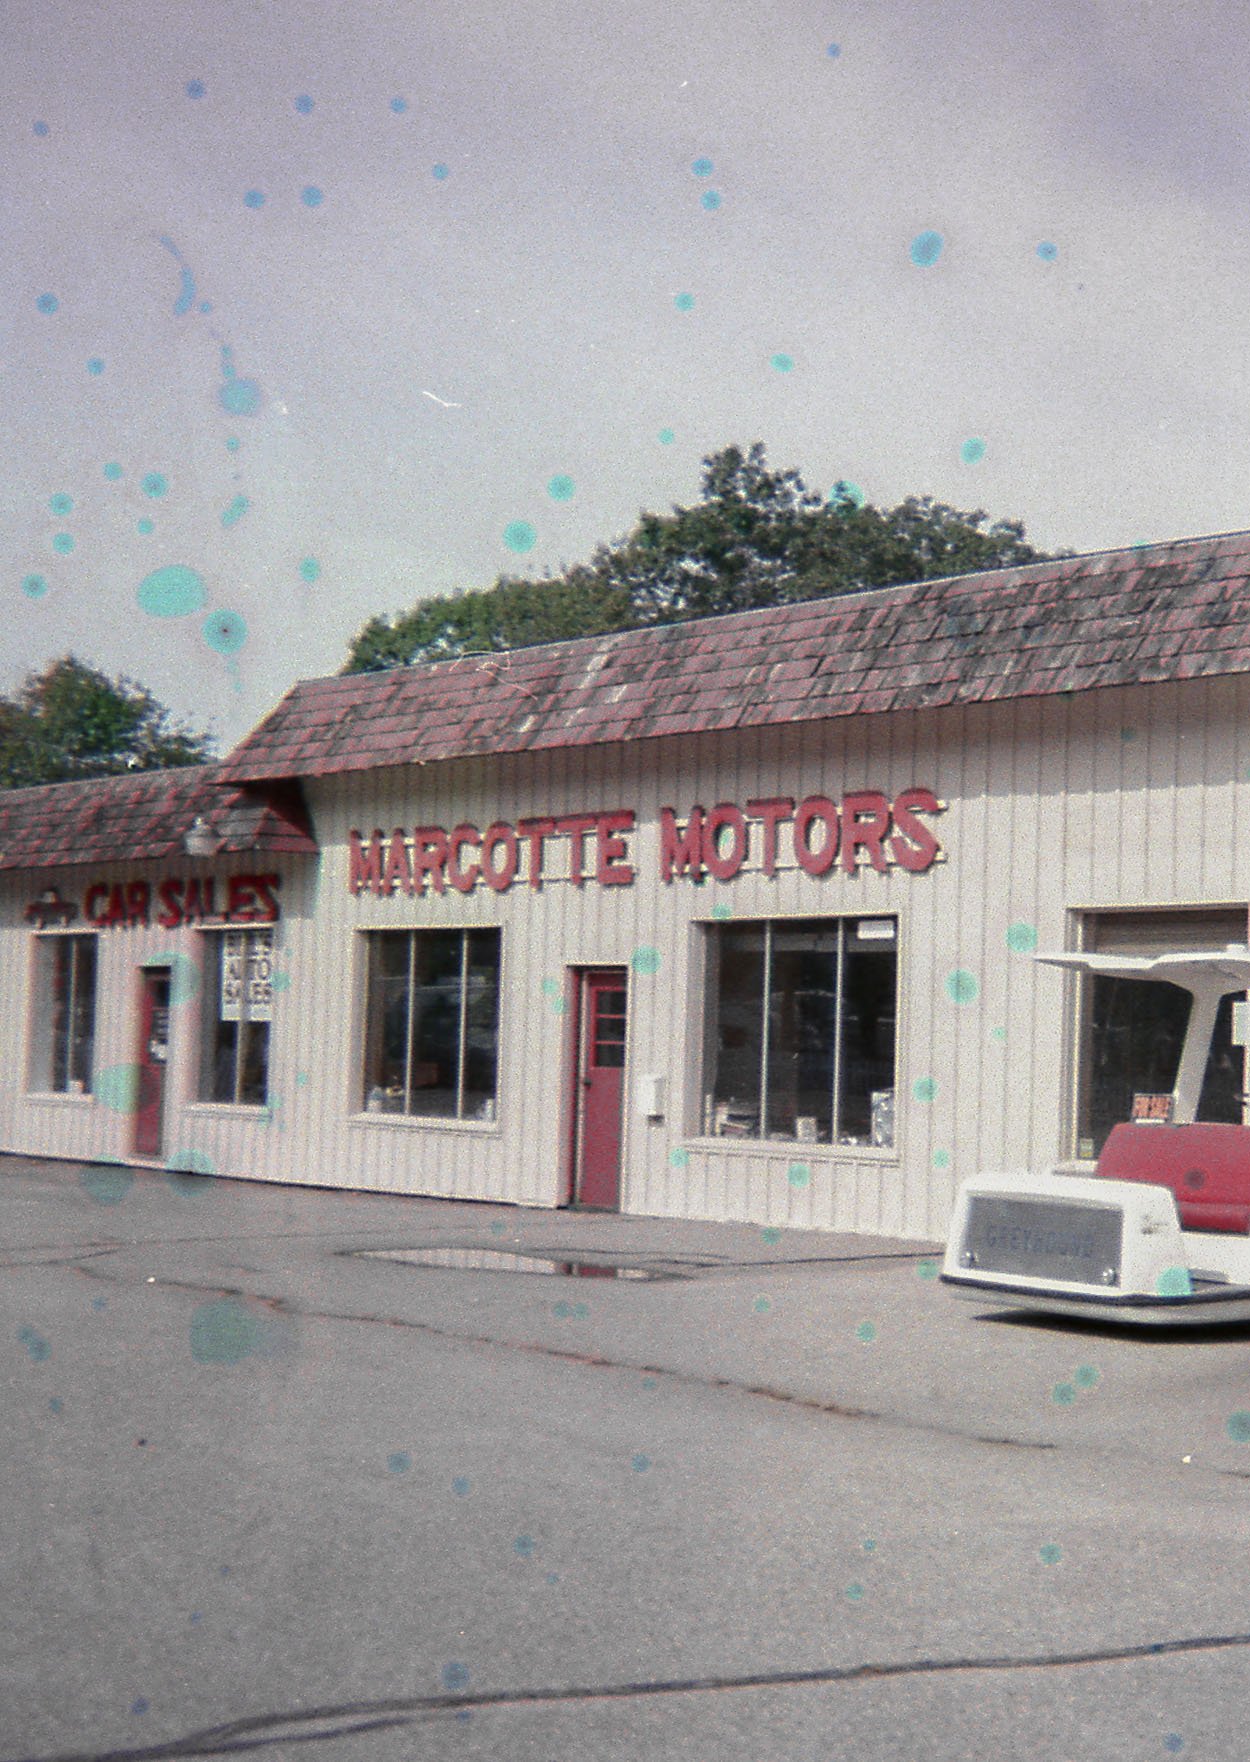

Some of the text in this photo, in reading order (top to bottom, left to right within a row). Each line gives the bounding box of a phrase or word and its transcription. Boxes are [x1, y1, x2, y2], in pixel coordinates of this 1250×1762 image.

[349, 788, 945, 895] MARCOTTE MOTORS
[83, 874, 281, 929] CAR SALES
[228, 957, 271, 980] ATO
